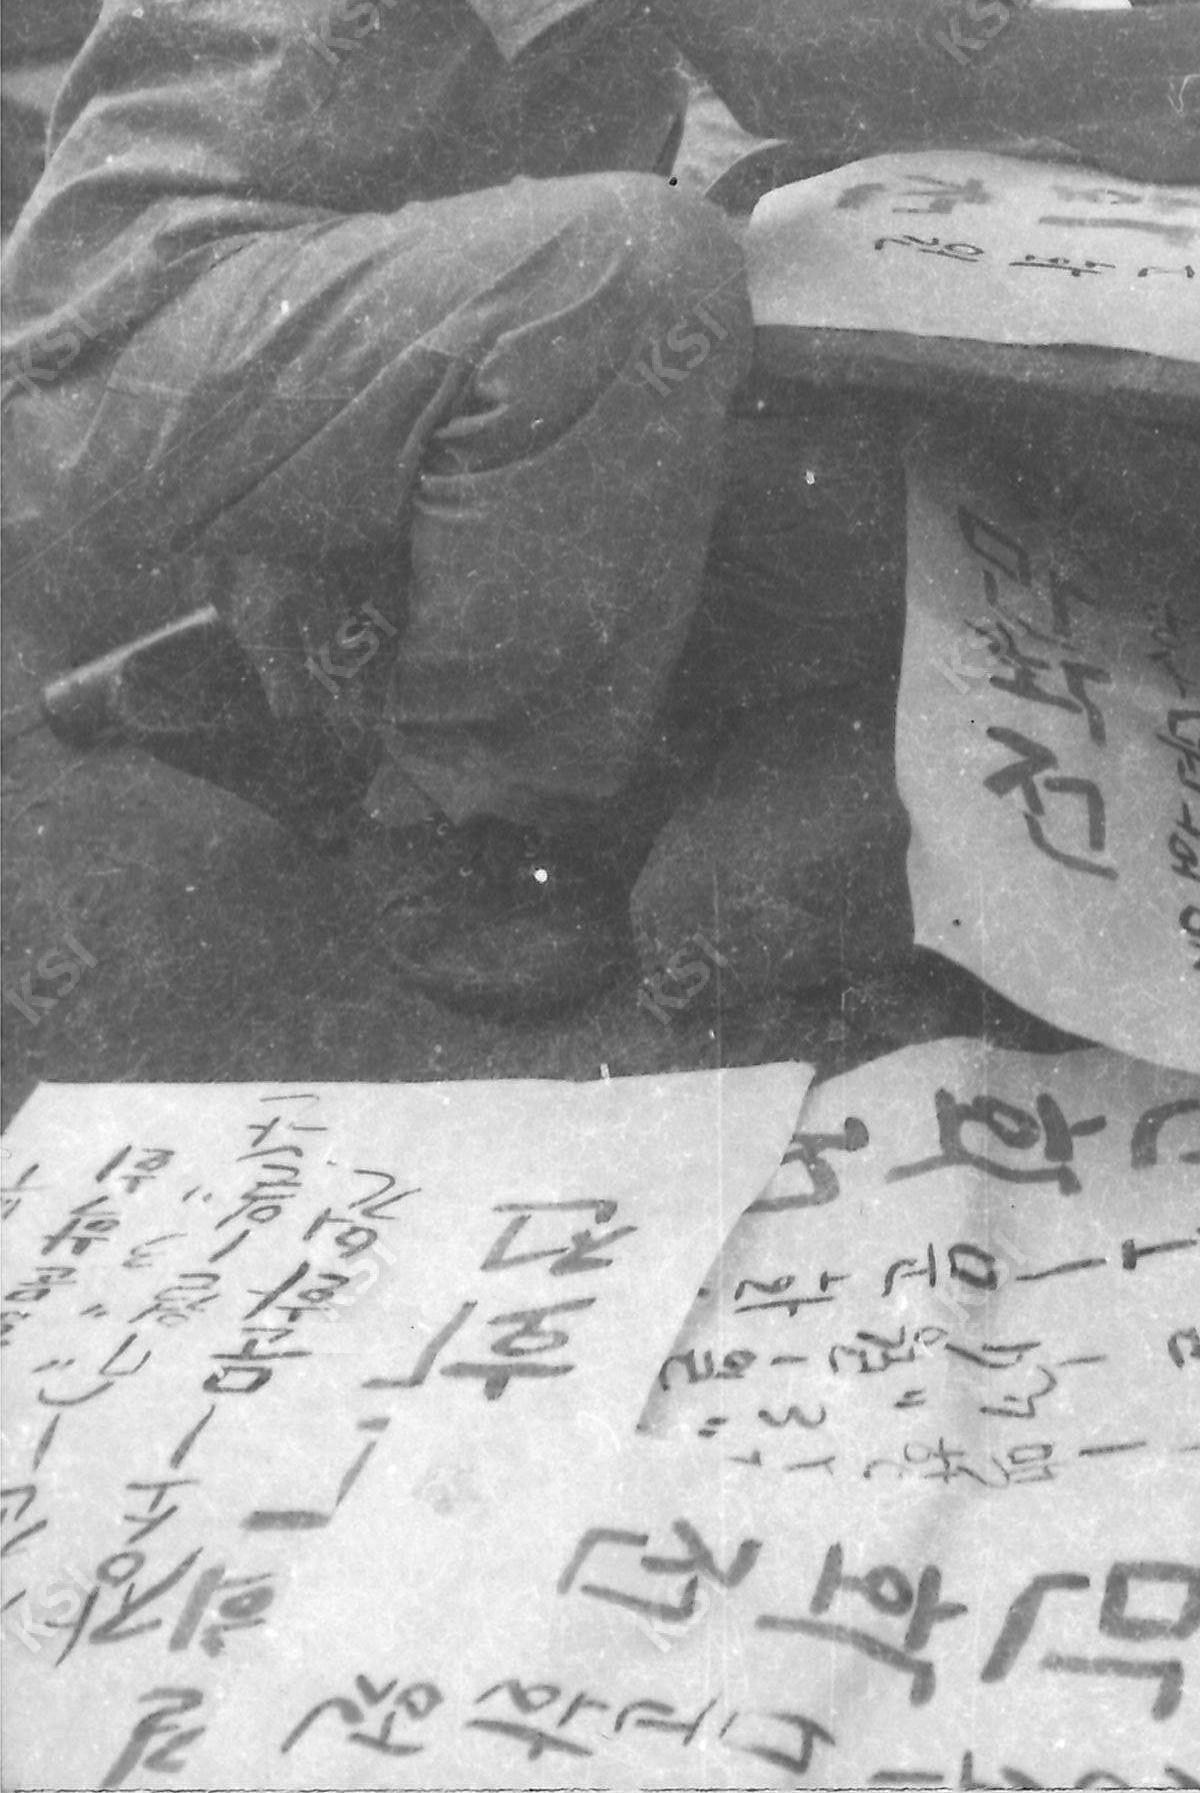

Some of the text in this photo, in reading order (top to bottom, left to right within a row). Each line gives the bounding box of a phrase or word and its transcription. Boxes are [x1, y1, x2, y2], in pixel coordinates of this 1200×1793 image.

[697, 1242, 1002, 1318] 문화
[45, 1167, 421, 1665] 장소 문화원
[281, 1671, 836, 1775] 문화원
